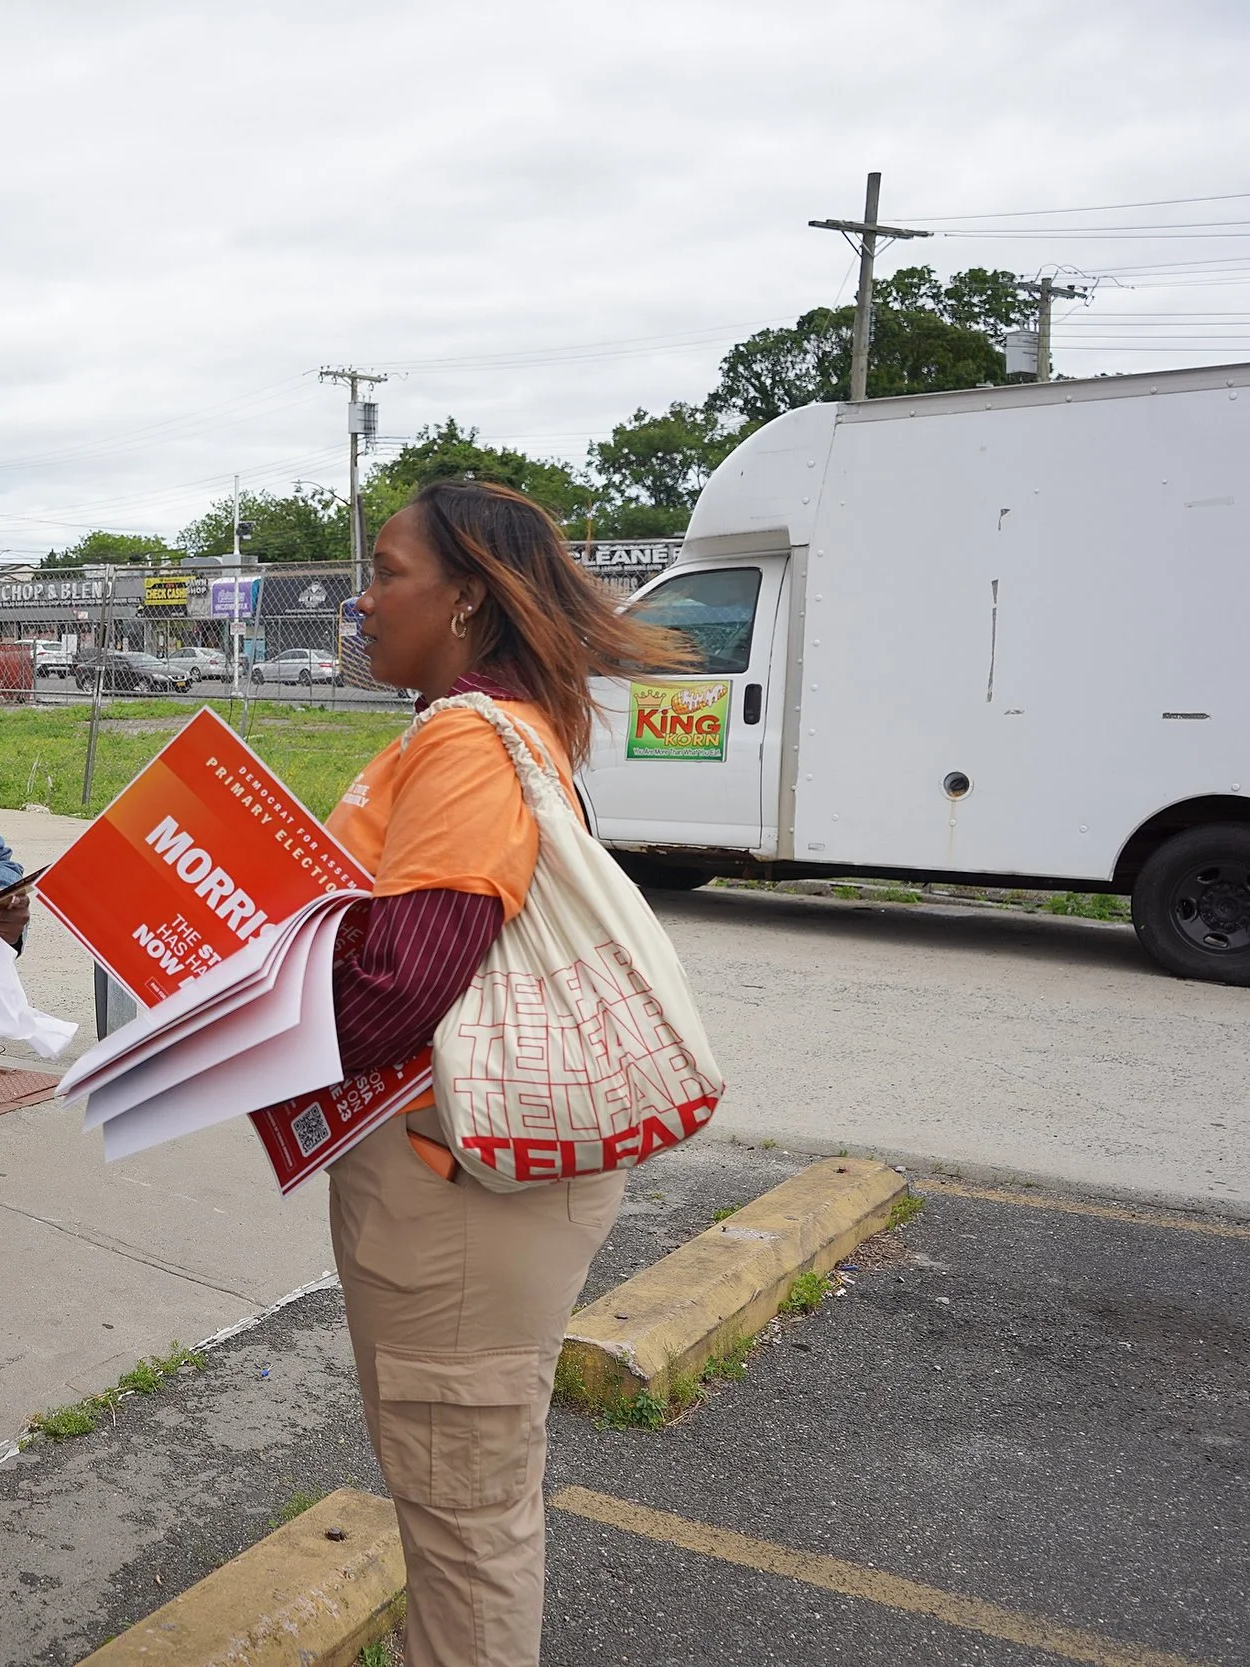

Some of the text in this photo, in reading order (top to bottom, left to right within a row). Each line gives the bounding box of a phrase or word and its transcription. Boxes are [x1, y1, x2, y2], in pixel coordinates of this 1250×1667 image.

[1, 583, 45, 601] CHOP
[47, 582, 58, 601] &
[145, 588, 167, 600] CHECK
[188, 586, 207, 596] SHOP
[655, 747, 668, 756] More
[684, 747, 698, 756] What
[663, 733, 720, 747] KORN
[205, 756, 273, 825] PRIMARY
[238, 766, 295, 825] DEMOCRAT
[296, 828, 319, 851] FOR
[156, 923, 188, 957] HAS
[171, 913, 202, 947] THE
[131, 923, 186, 976] NOW
[458, 993, 684, 1083] TELFAR
[347, 1089, 364, 1114] ON
[453, 1045, 718, 1141] TELFAR
[336, 1103, 353, 1123] 23
